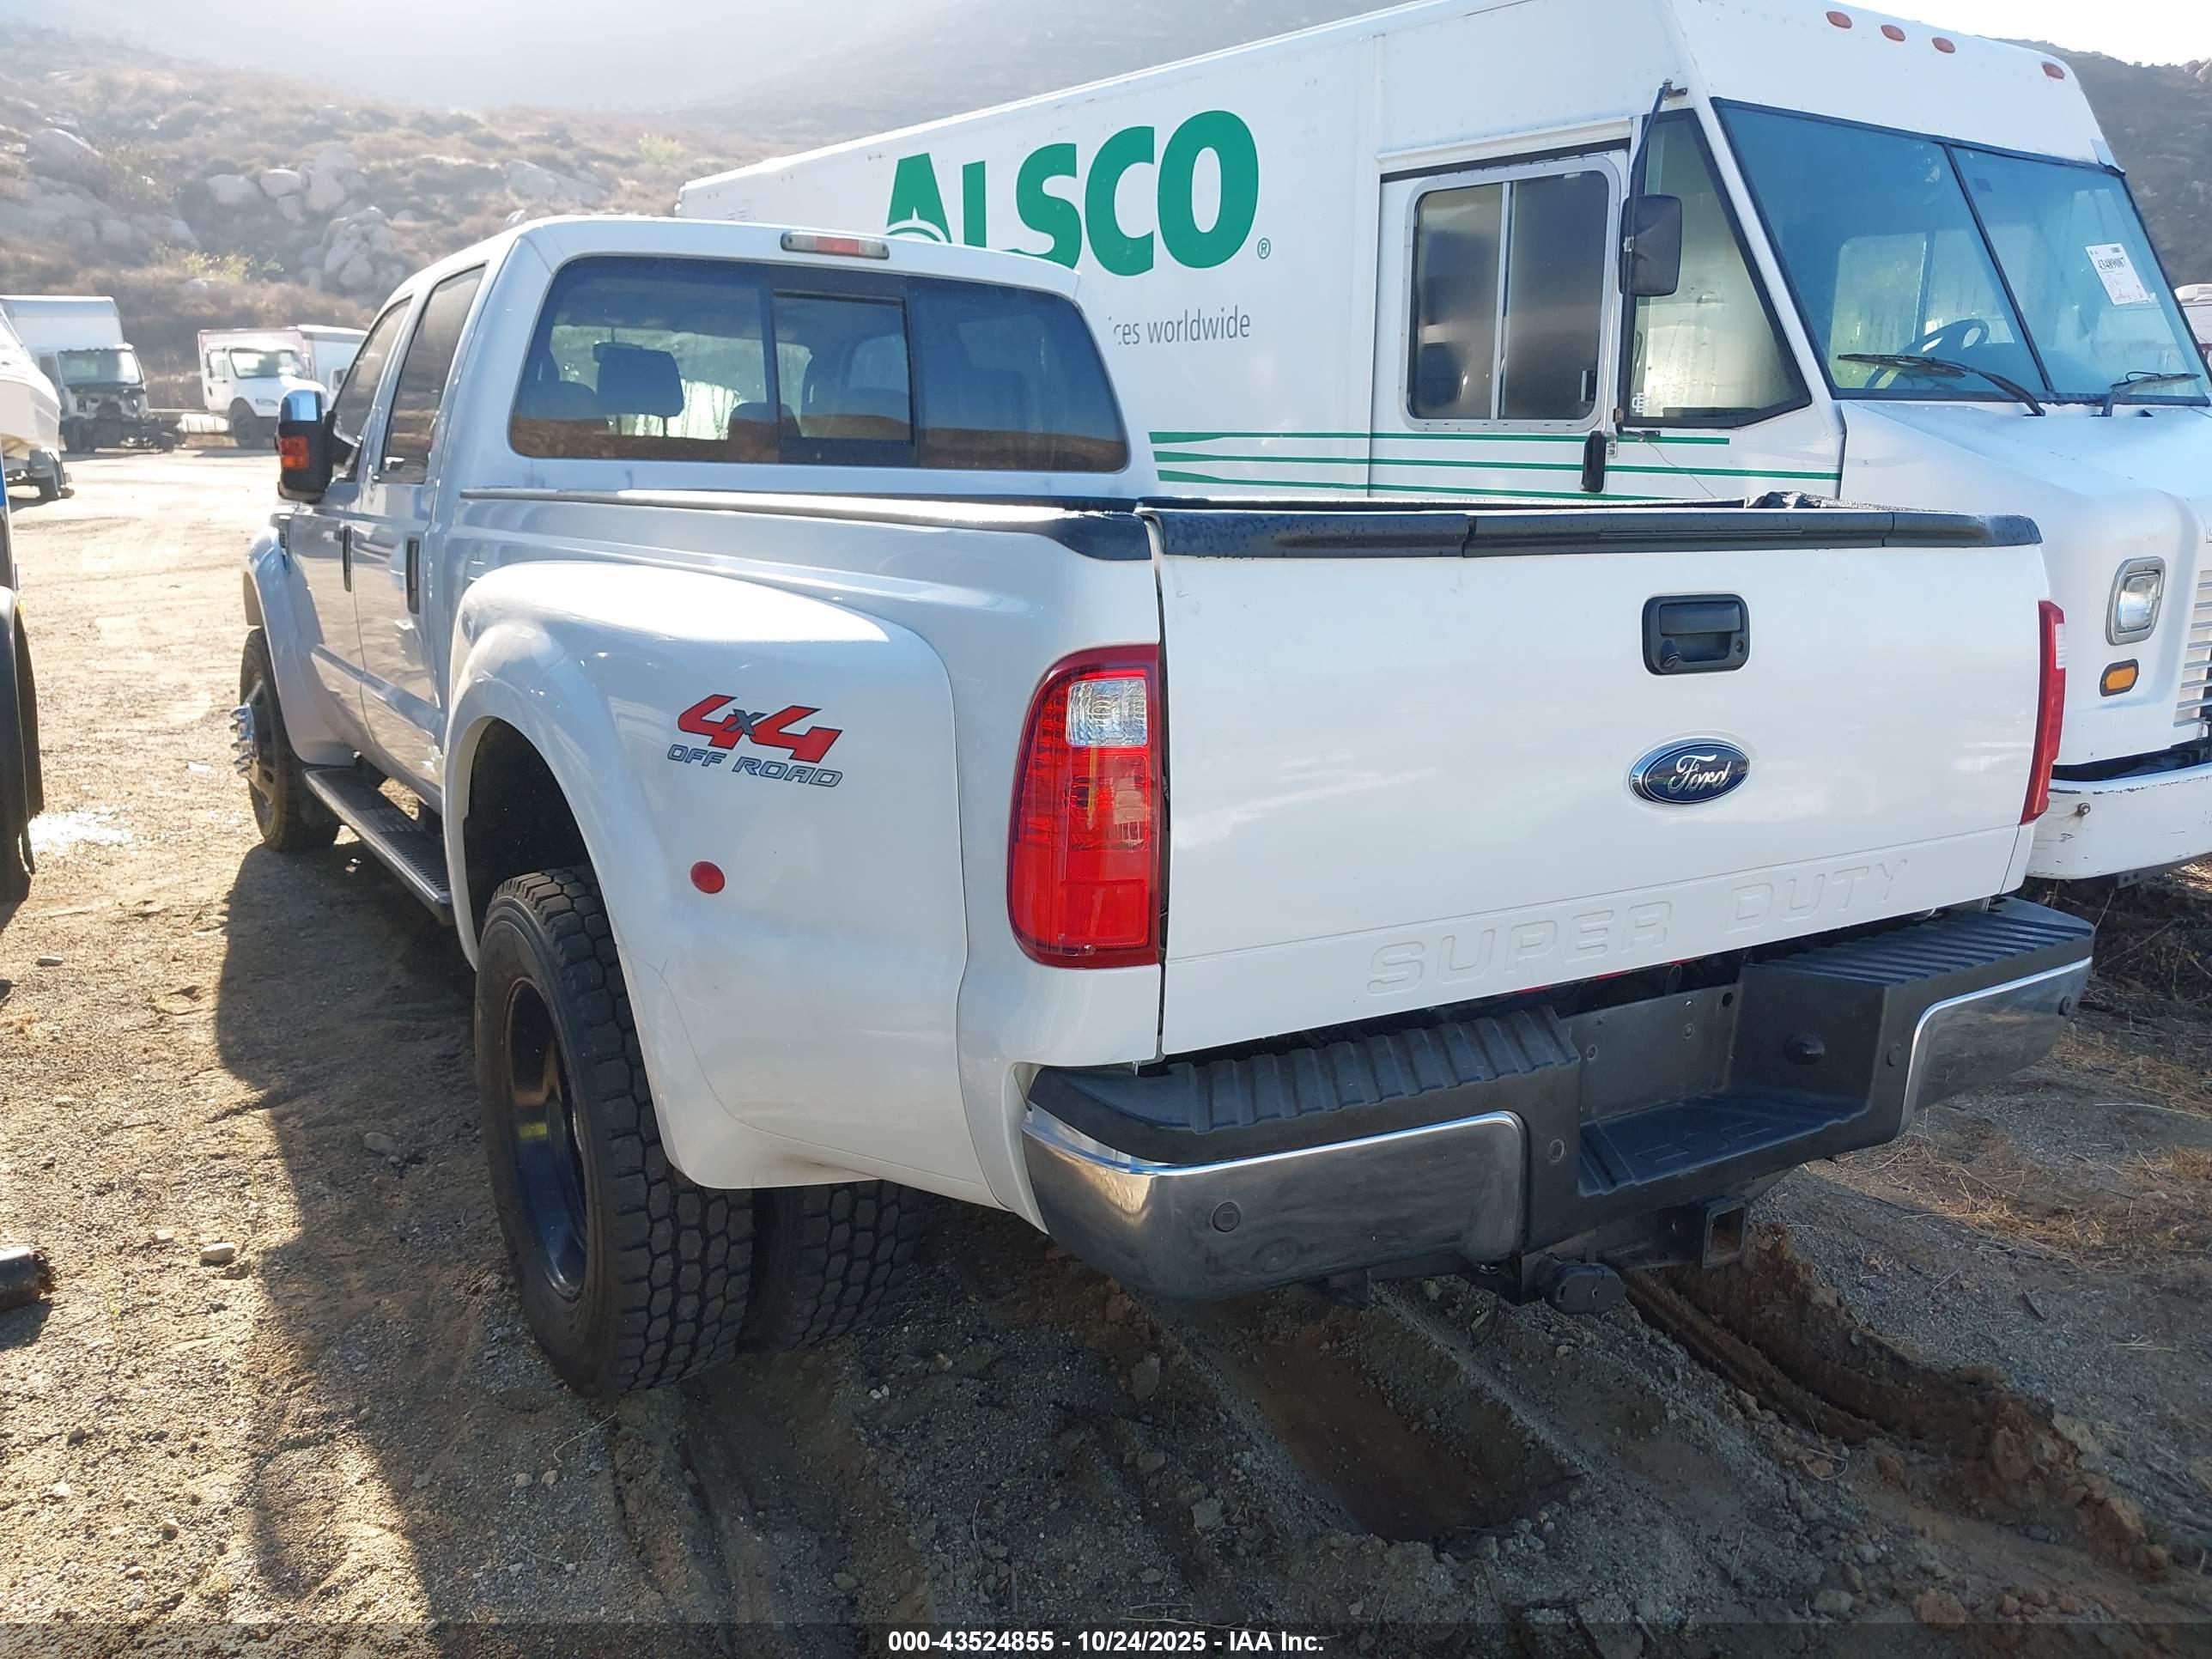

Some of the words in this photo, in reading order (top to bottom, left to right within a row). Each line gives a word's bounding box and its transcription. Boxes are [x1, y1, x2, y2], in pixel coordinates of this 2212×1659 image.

[886, 110, 1259, 276] ALSCO
[1147, 305, 1251, 343] worldwide
[667, 744, 727, 767] OFF
[732, 757, 843, 787] ROAD
[1668, 754, 1732, 793] Ford
[1367, 900, 1672, 998] SUPER
[1726, 858, 1909, 934] DUTY
